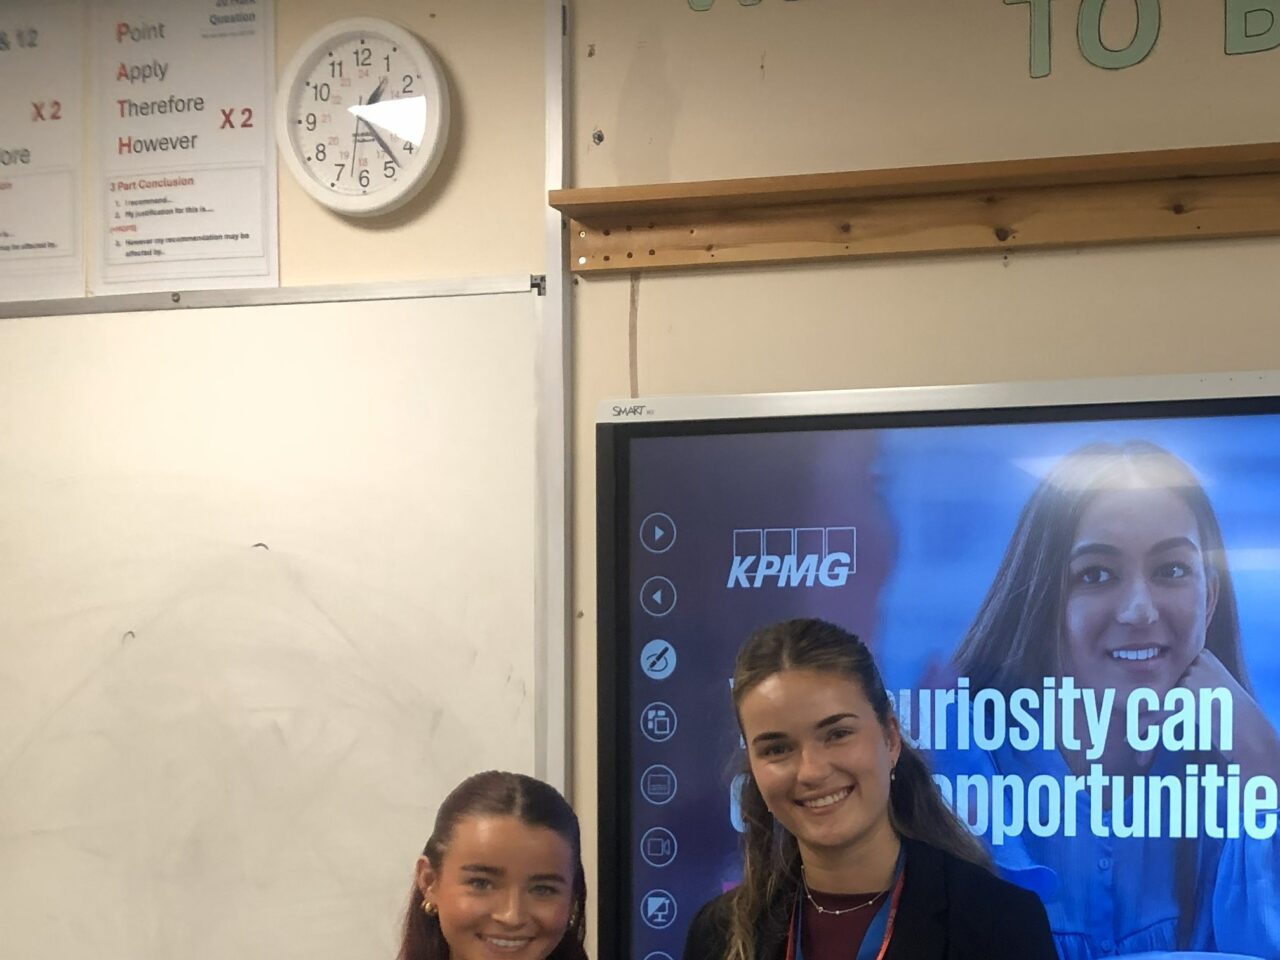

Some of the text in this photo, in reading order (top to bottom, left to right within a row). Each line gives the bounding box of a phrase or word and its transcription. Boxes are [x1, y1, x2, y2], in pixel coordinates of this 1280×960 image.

[116, 22, 165, 43] Point
[1004, 0, 1161, 78] TO
[353, 48, 372, 67] 12
[384, 55, 391, 72] 1
[116, 61, 169, 84] Apply
[329, 61, 343, 78] 11
[312, 83, 330, 102] 10
[402, 75, 414, 94] 2
[49, 100, 62, 120] 2
[117, 96, 204, 118] Therefore
[241, 108, 254, 128] 2
[306, 113, 317, 132] 9
[118, 134, 198, 154] However
[315, 143, 327, 162] 8
[403, 141, 414, 154] 4
[334, 164, 345, 182] 7
[359, 169, 370, 188] 6
[384, 161, 395, 179] 5
[118, 181, 136, 190] Part
[138, 177, 194, 189] Conclusion
[612, 404, 646, 417] SMART
[726, 552, 851, 588] KPMG
[1126, 686, 1233, 752] can
